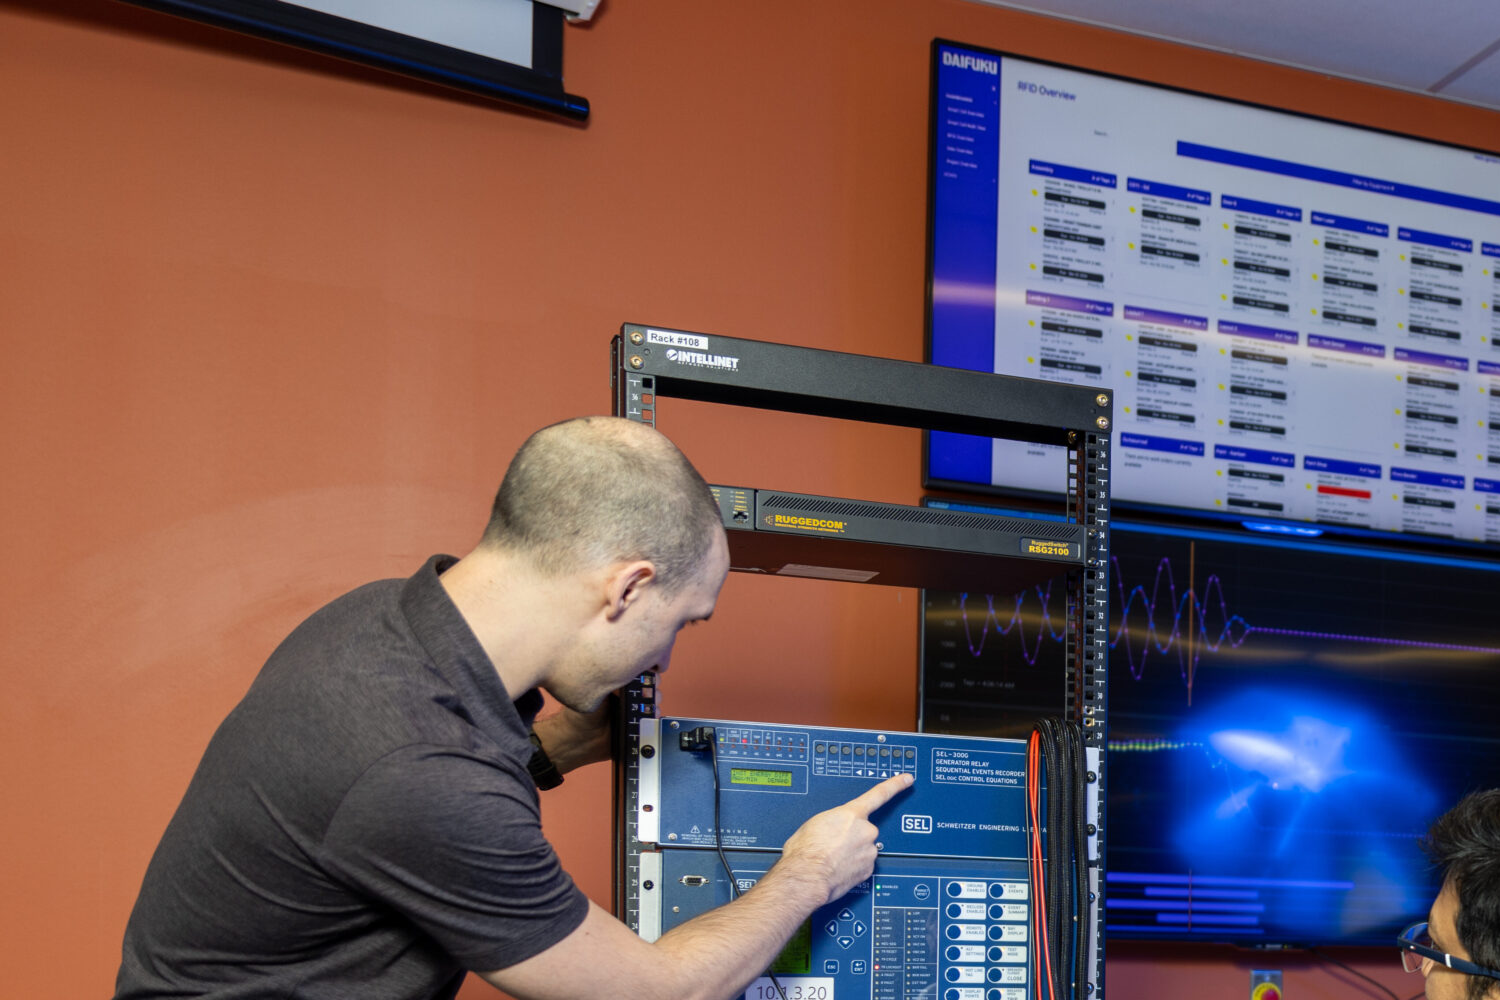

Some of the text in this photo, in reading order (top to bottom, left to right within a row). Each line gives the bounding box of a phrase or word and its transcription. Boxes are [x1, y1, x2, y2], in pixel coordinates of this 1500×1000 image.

[942, 52, 998, 75] DAIFUKU
[1018, 81, 1077, 102] RFID Overview
[651, 333, 699, 347] Rack #108
[678, 351, 739, 369] INTELLINET
[775, 515, 843, 529] RUGGEDCOM
[1029, 546, 1069, 556] RSG2100
[906, 819, 928, 830] SEL
[979, 824, 1019, 832] ENGINEERING
[758, 986, 826, 1000] 10.1.3.20
